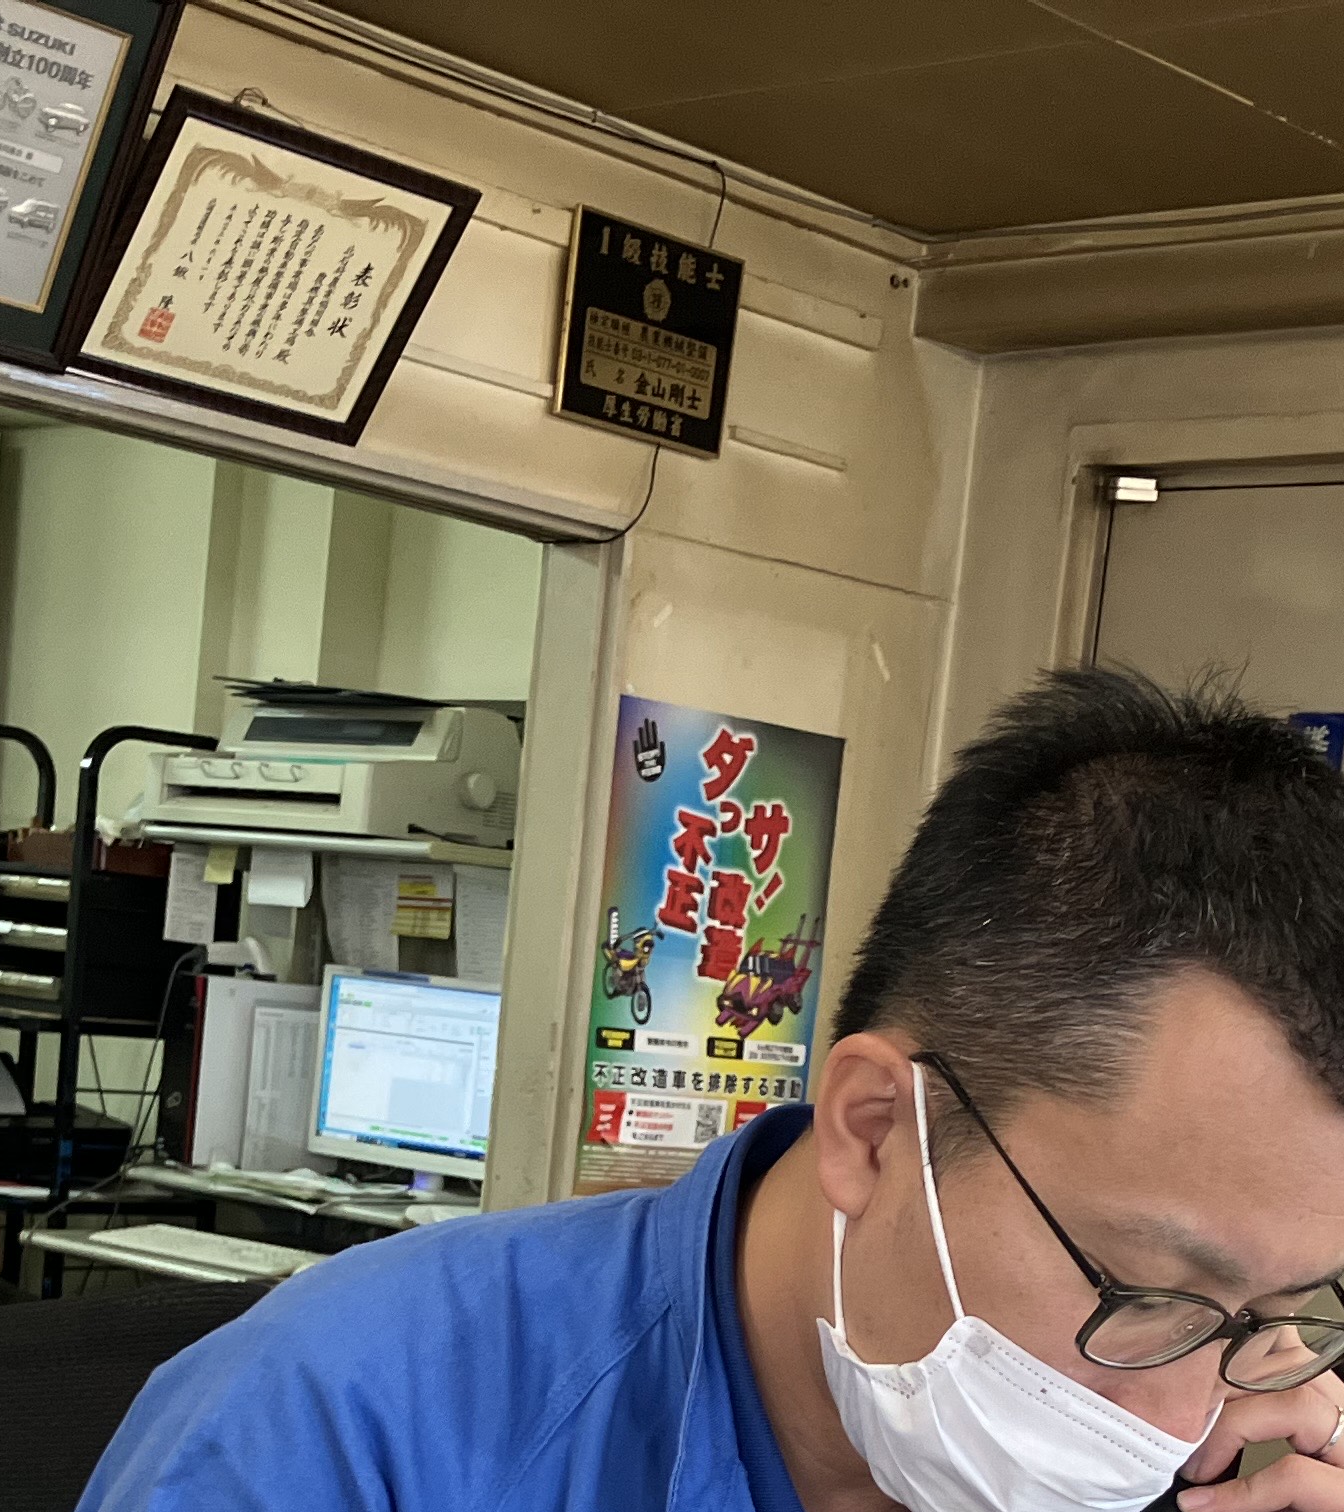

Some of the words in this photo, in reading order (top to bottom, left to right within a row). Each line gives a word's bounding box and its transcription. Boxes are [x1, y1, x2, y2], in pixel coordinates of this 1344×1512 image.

[7, 22, 76, 56] SUZUKI
[327, 262, 375, 338] 表彰状
[634, 371, 702, 412] 金山剛士
[592, 1061, 804, 1101] 不正改造車を排除する運動
